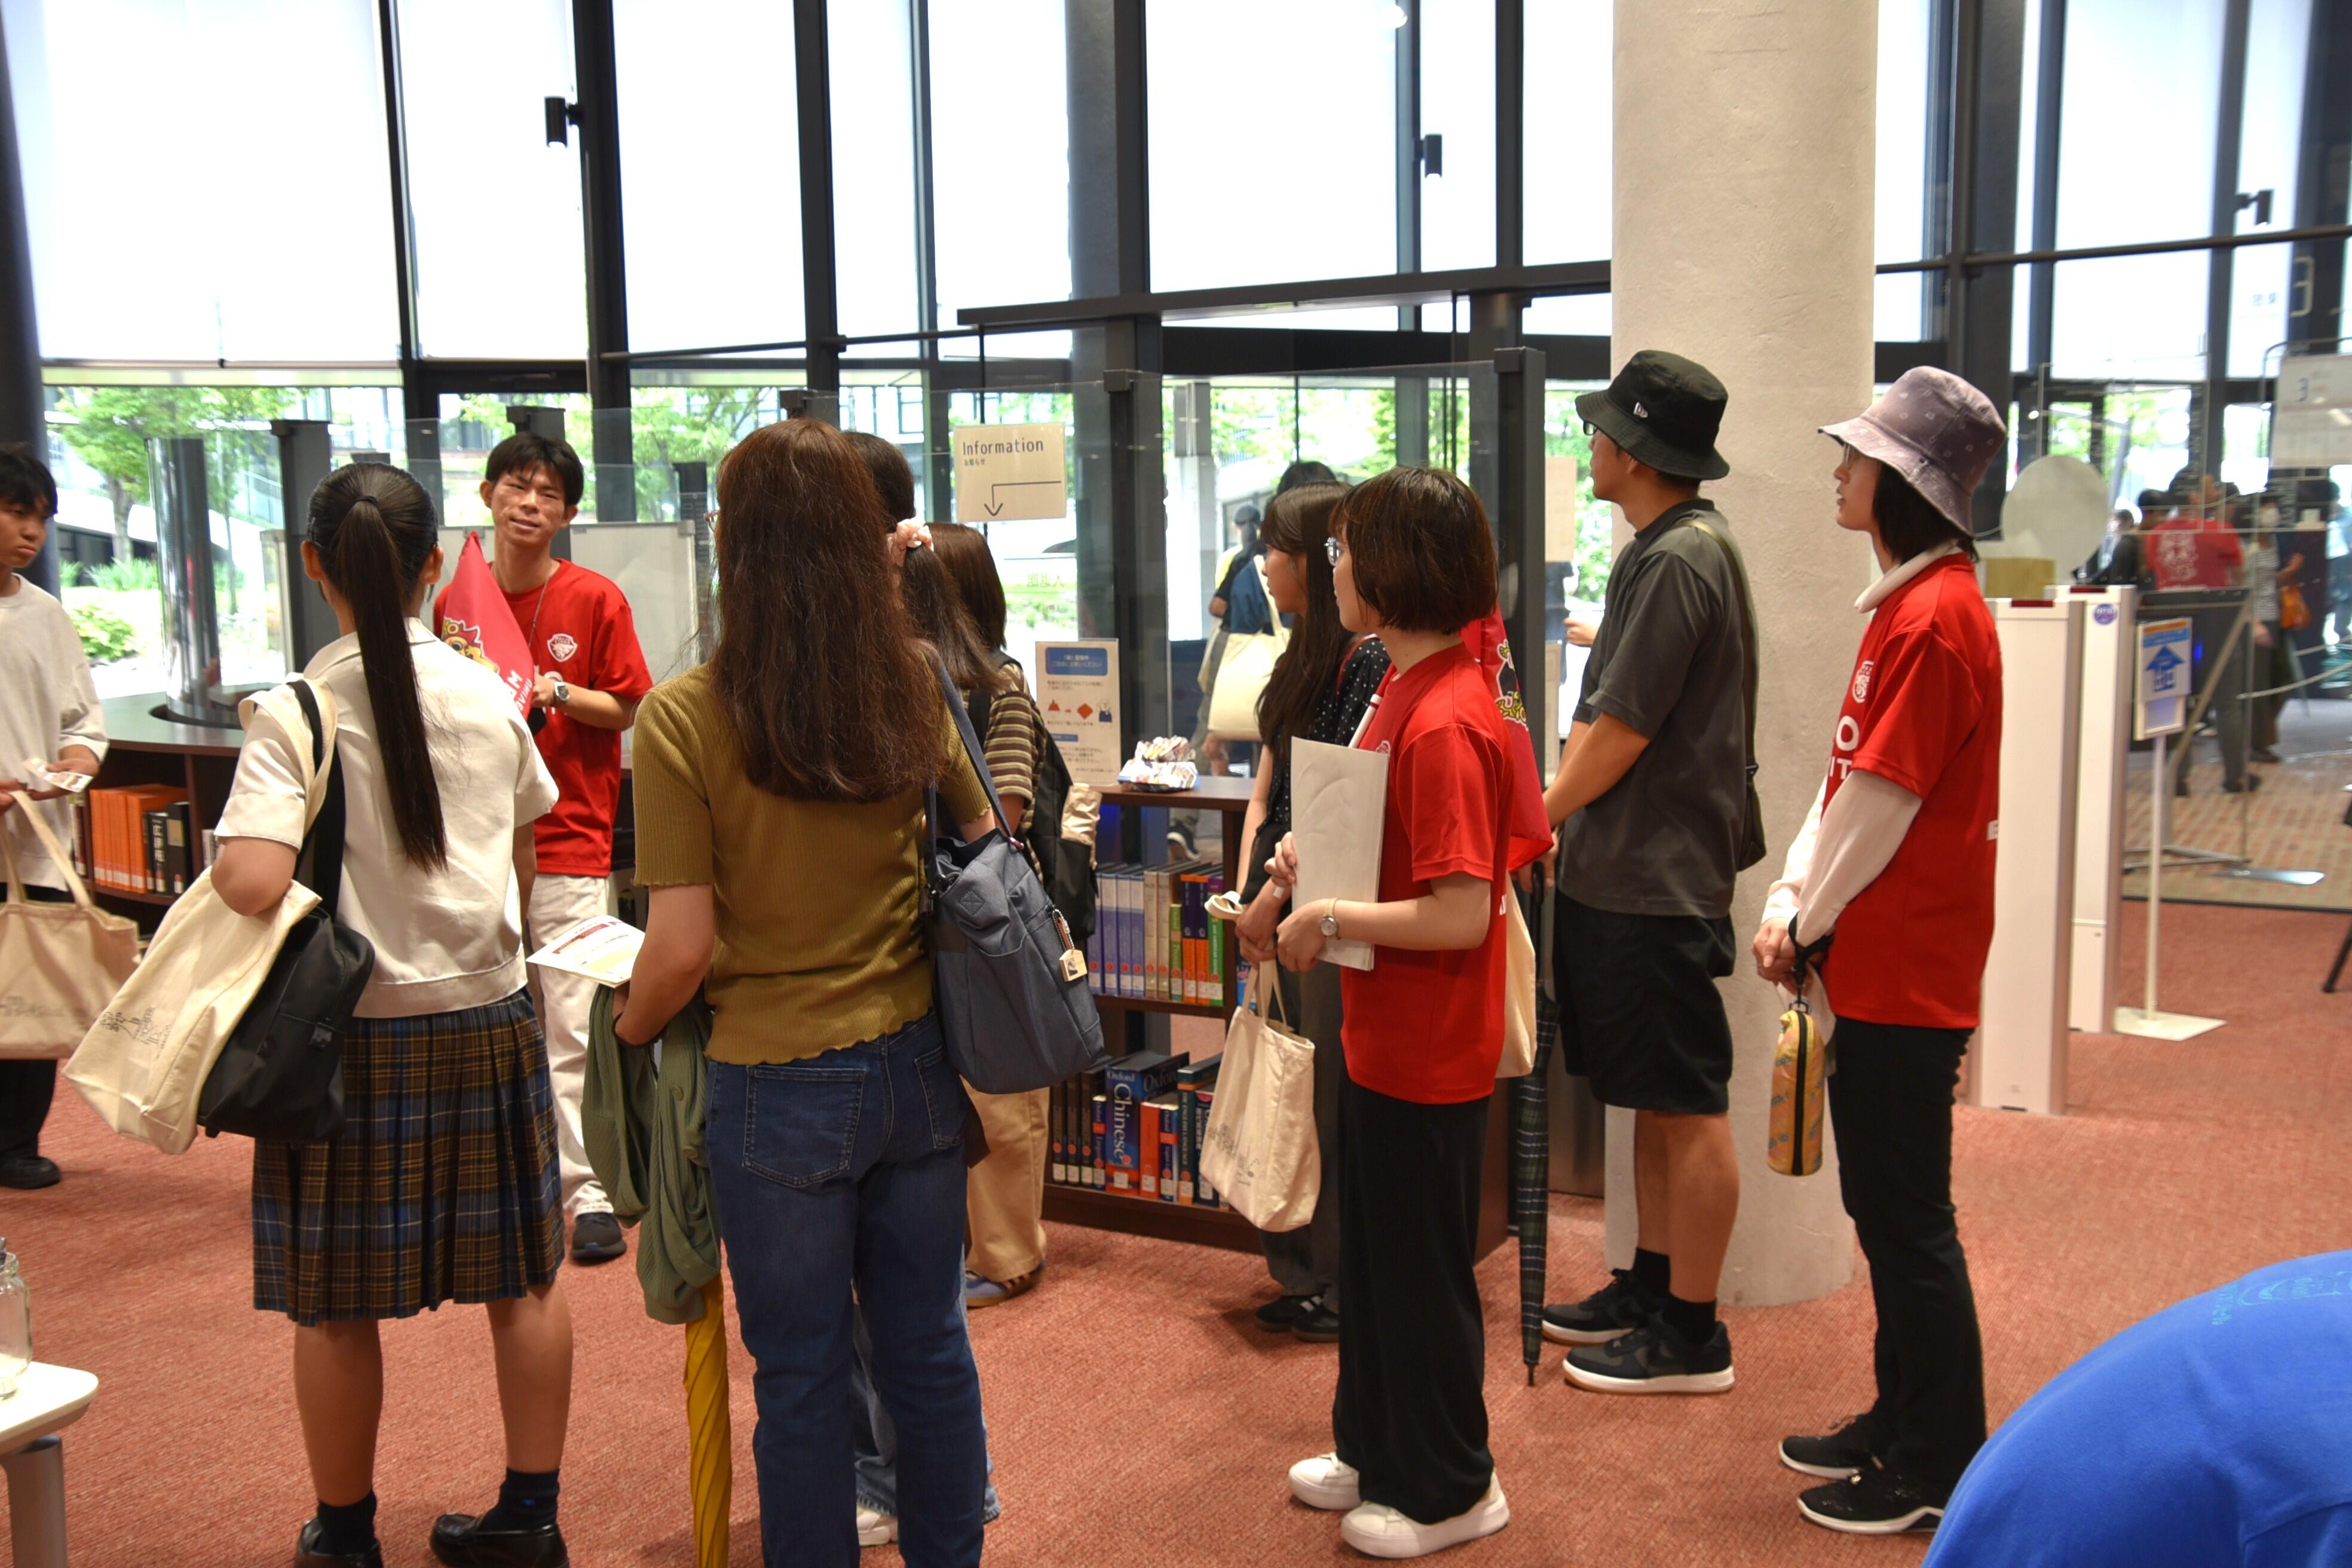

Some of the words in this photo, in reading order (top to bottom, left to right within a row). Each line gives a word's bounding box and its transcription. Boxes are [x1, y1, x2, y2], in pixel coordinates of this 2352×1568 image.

[963, 437, 1044, 456] Information
[964, 458, 986, 467] お知らせ
[1106, 1070, 1136, 1082] Oxford
[1113, 1083, 1134, 1158] Chinese
